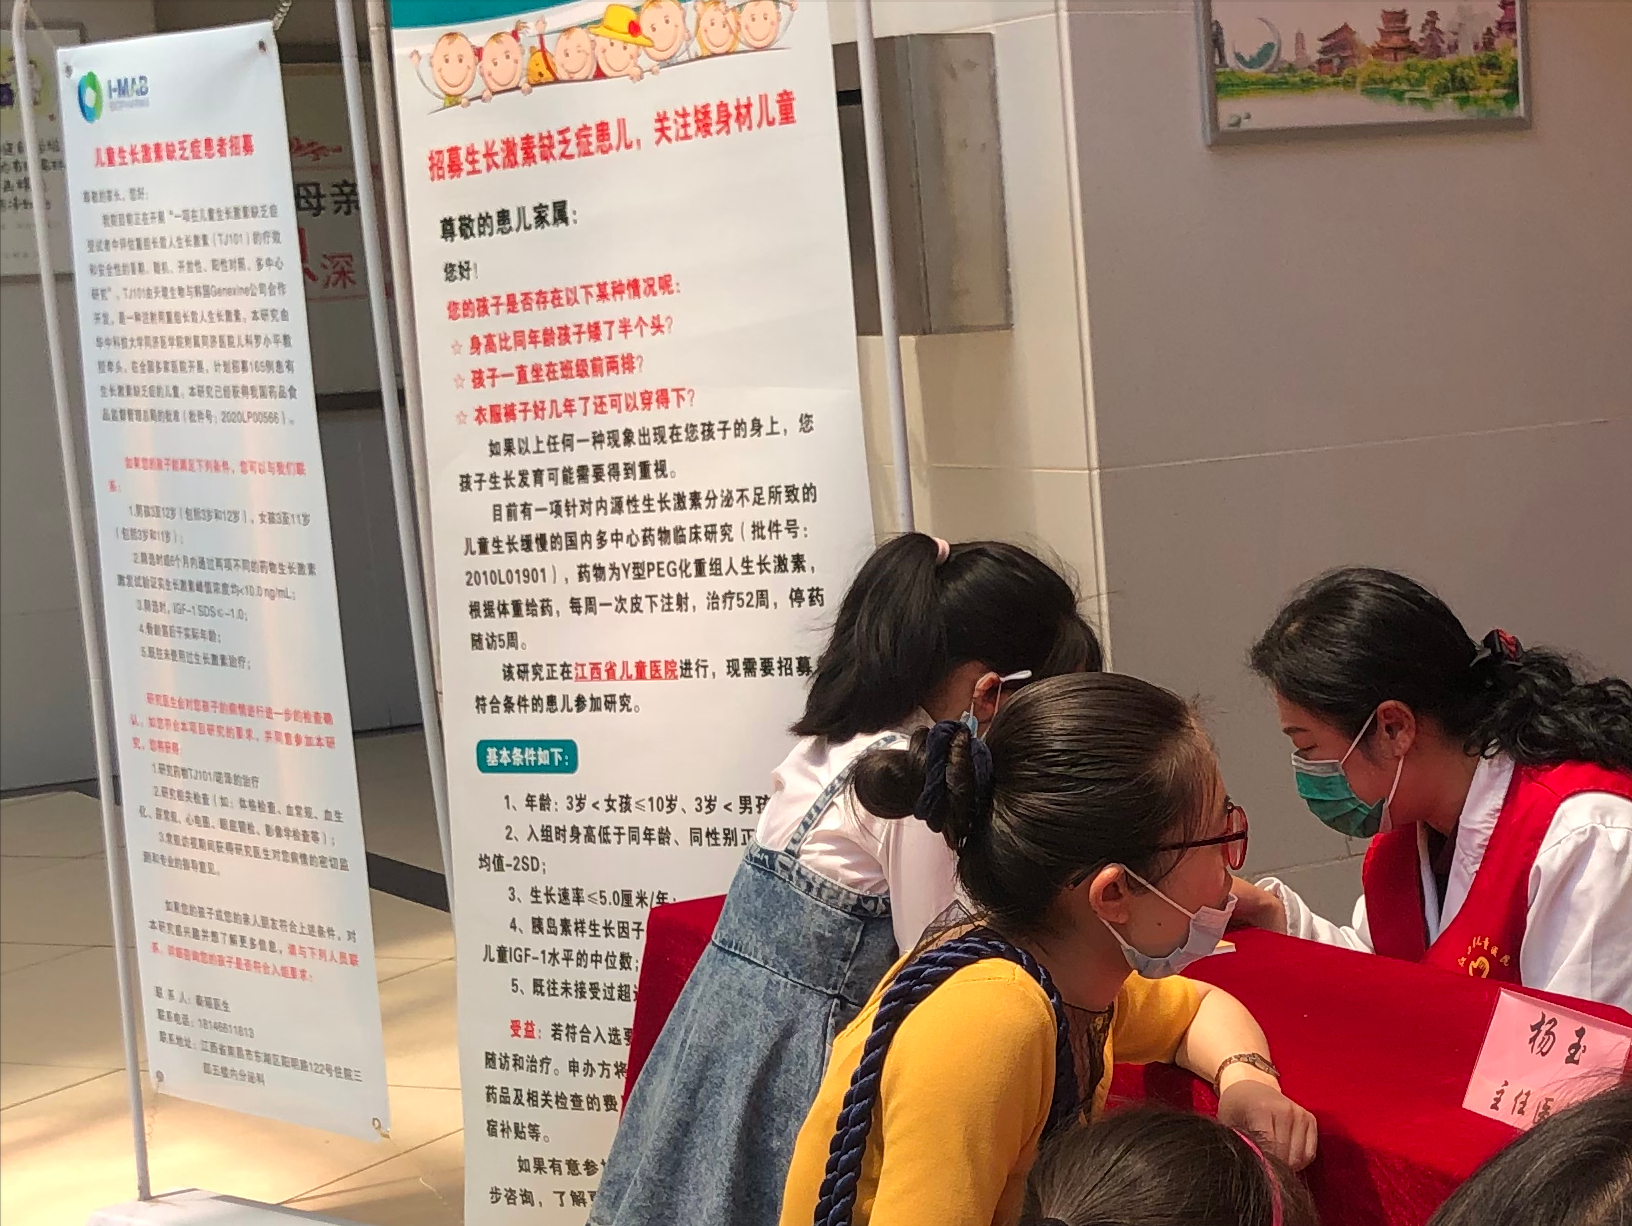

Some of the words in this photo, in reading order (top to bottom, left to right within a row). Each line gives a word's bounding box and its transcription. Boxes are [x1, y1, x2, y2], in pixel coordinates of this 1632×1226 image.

[428, 89, 797, 182] 招募生长激素缺乏症患儿，关注矮身材儿童
[440, 200, 578, 243] 尊敬的患儿家属：
[444, 260, 478, 283] 您好！
[447, 274, 681, 320] 您的孩子是否存在以下某种情况呢：
[488, 413, 815, 458] 如果以上任何一种现象出现在您孩子的身上，您
[459, 459, 677, 492] 孩子生长发育可能需要得到重视。
[492, 482, 817, 523] 目前有一项针对内源性生长激素分泌不足所致的
[469, 586, 825, 619] 根据体重给药，每周一次皮下注射，治疗52周，停药
[470, 632, 527, 651] 随访5周。
[475, 693, 640, 714] 符合条件的患儿参加研究。
[486, 747, 569, 767] 基本条件如下：
[510, 917, 644, 940] 4、胰岛素样生长因子
[1528, 1011, 1587, 1066] 杨玉
[485, 1085, 618, 1112] 药品及相关检查的费
[486, 1119, 550, 1144] 宿补贴等。
[517, 1156, 606, 1176] 如果有意参
